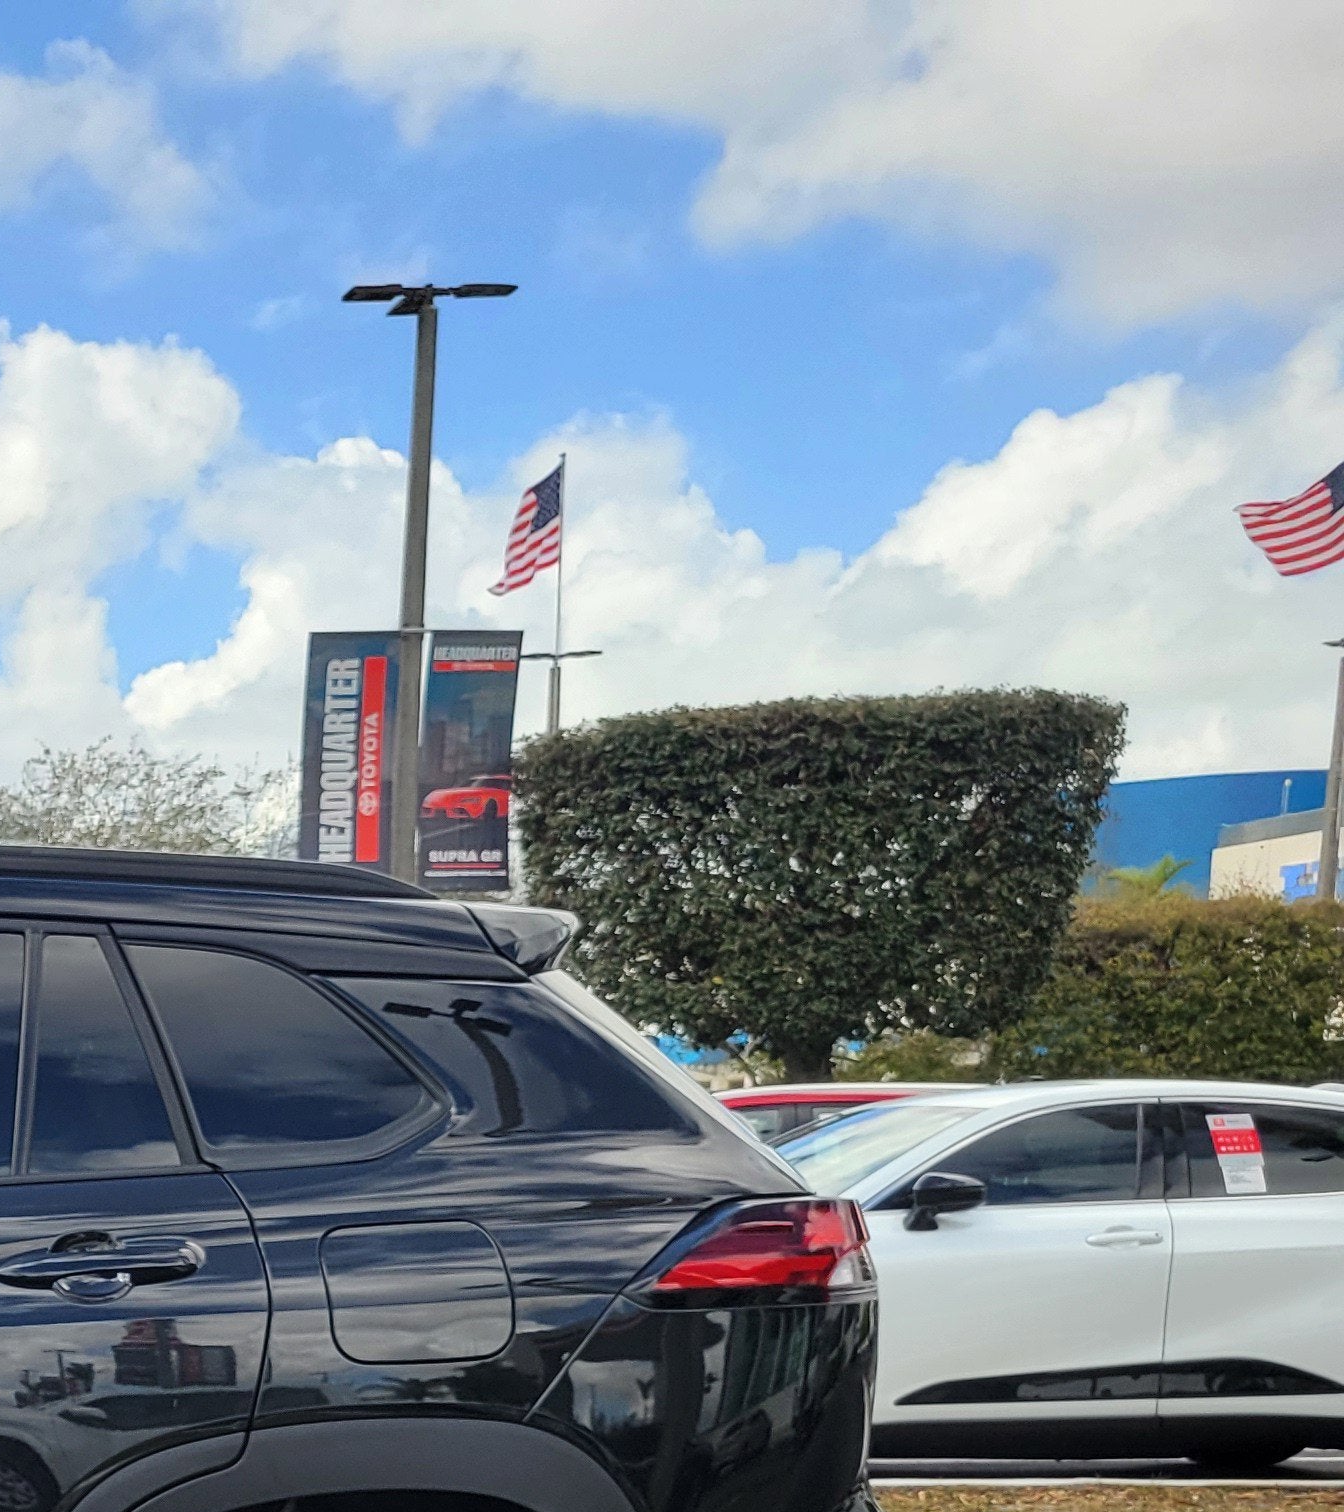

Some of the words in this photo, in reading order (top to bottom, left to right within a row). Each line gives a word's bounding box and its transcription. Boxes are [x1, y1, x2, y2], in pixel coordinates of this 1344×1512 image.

[319, 657, 362, 863] HEADQUARTER
[362, 712, 380, 787] TOYOTA
[428, 850, 478, 862] SUPRA
